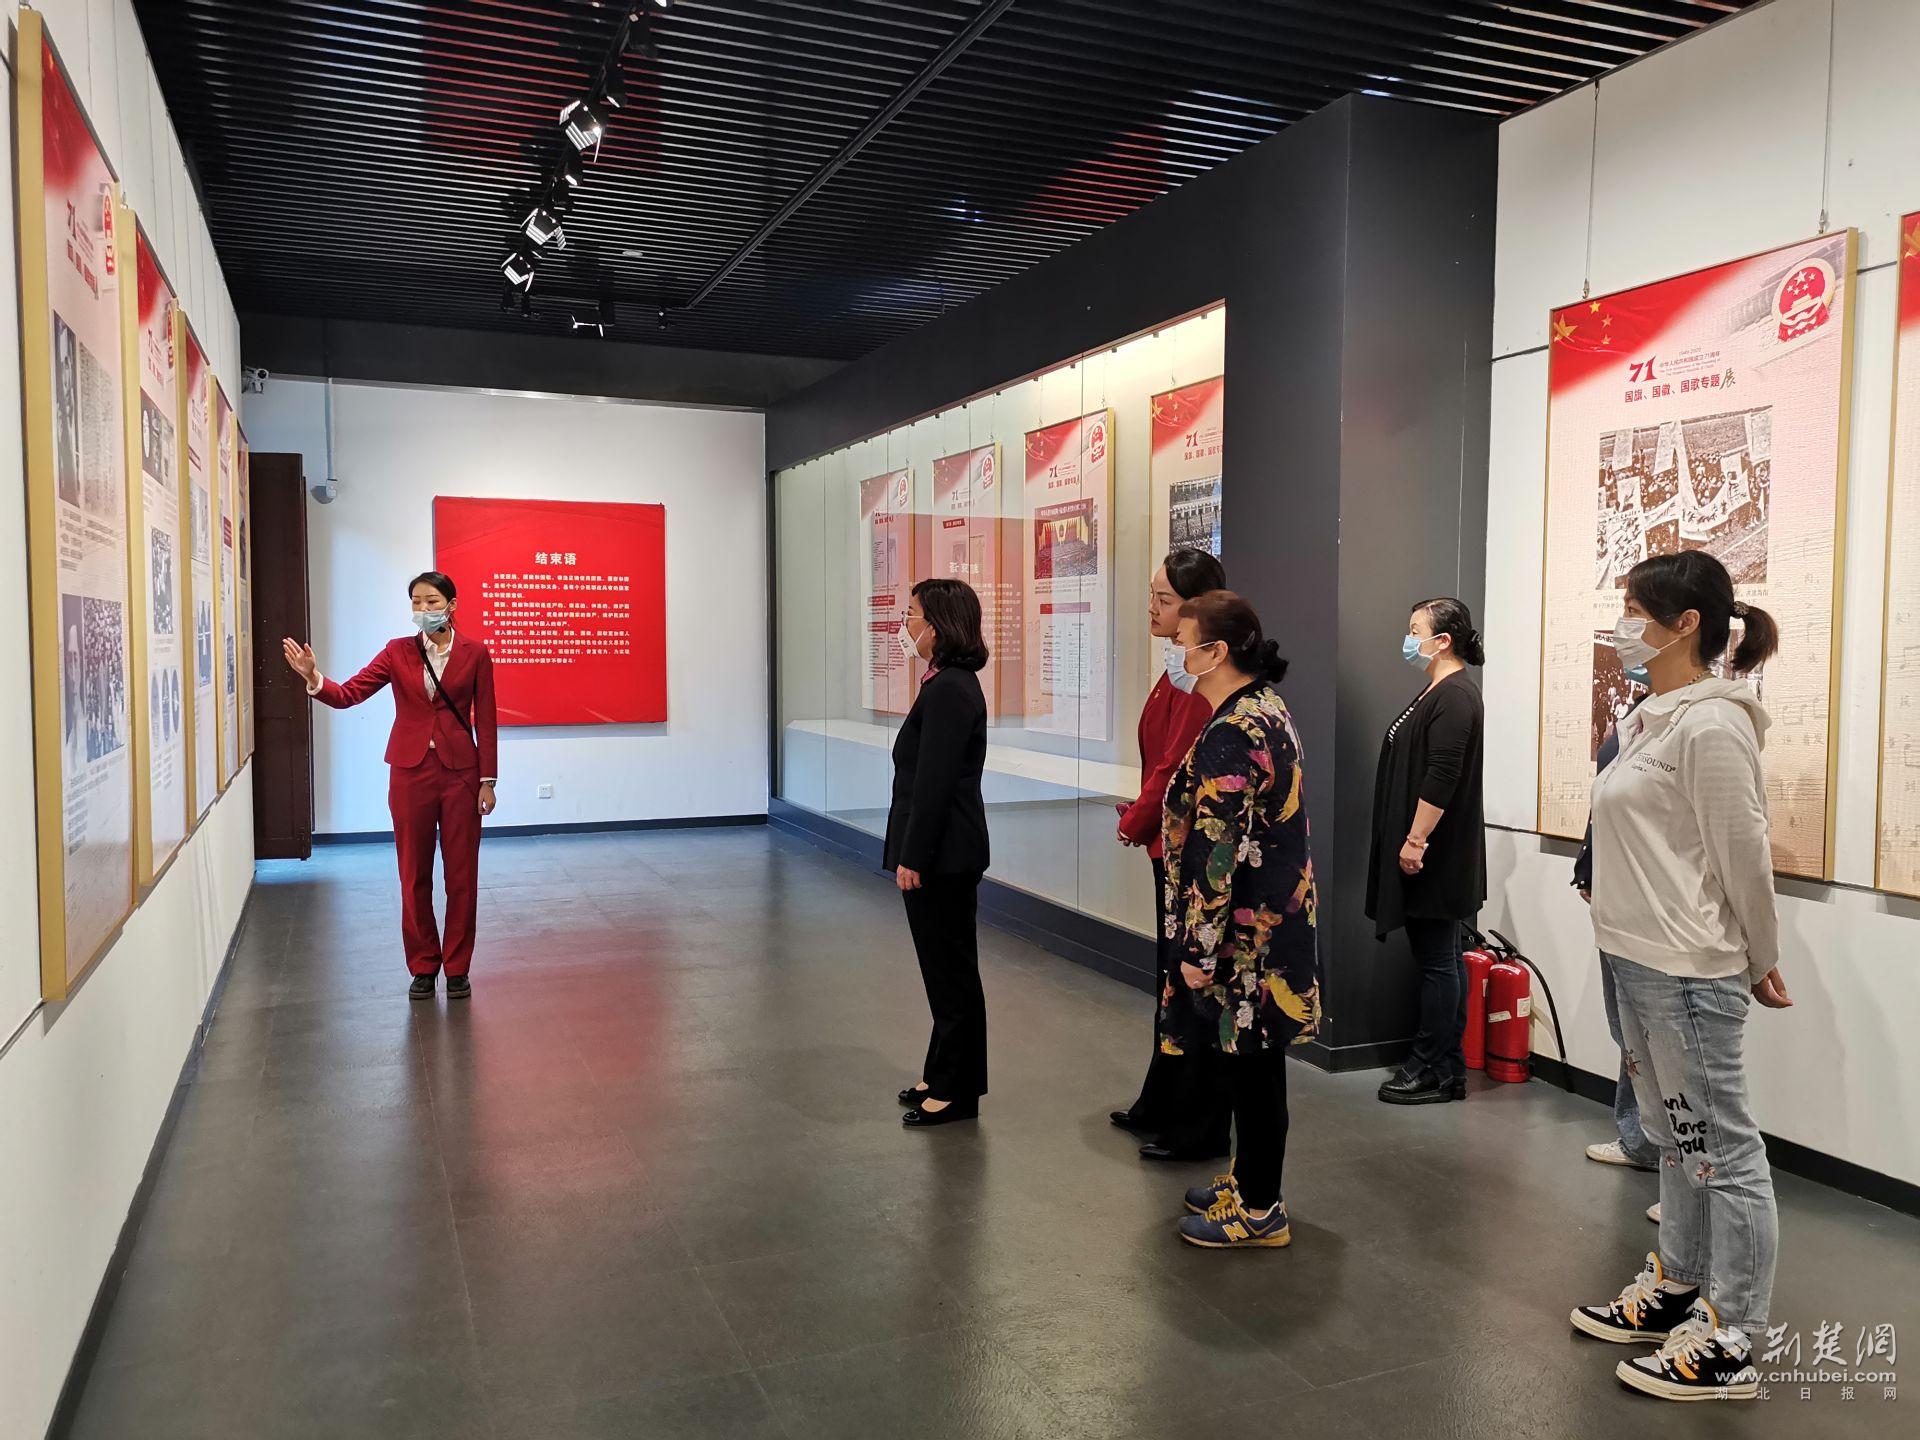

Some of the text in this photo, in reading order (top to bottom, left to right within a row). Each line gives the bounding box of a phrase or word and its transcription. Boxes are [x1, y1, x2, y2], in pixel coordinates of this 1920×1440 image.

[1628, 355, 1657, 383] 71
[1186, 430, 1198, 447] 71
[1049, 465, 1058, 478] 71
[535, 551, 576, 566] 结束语
[1670, 1113, 1707, 1136] love
[1674, 1136, 1708, 1164] you
[1222, 1221, 1250, 1242] N
